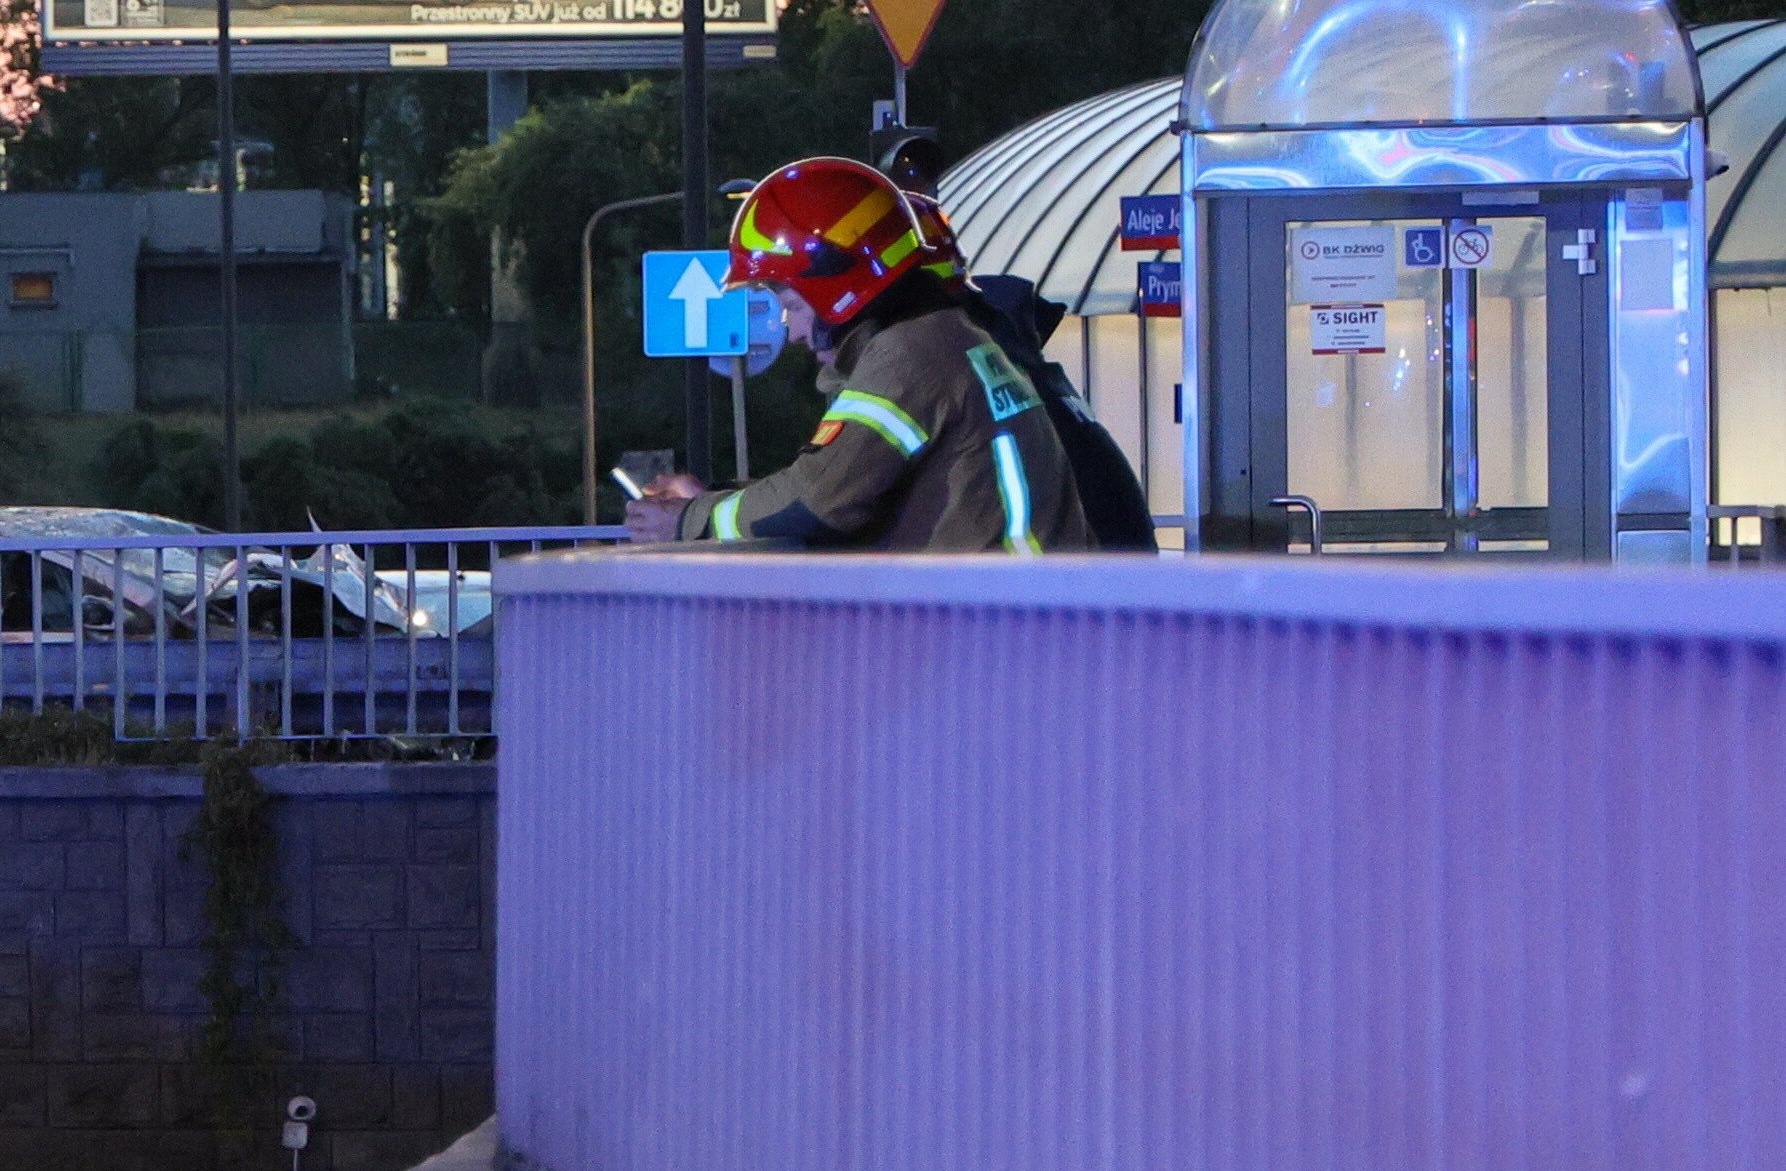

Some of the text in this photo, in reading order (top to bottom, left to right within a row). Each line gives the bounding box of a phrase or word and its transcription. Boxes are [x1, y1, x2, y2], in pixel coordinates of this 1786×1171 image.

[411, 5, 510, 23] Przestronny
[514, 5, 552, 21] SUV
[553, 4, 584, 24] już
[587, 3, 607, 20] od
[1127, 208, 1164, 236] Aleje
[1323, 245, 1340, 255] BK
[1333, 311, 1379, 325] SIGHT
